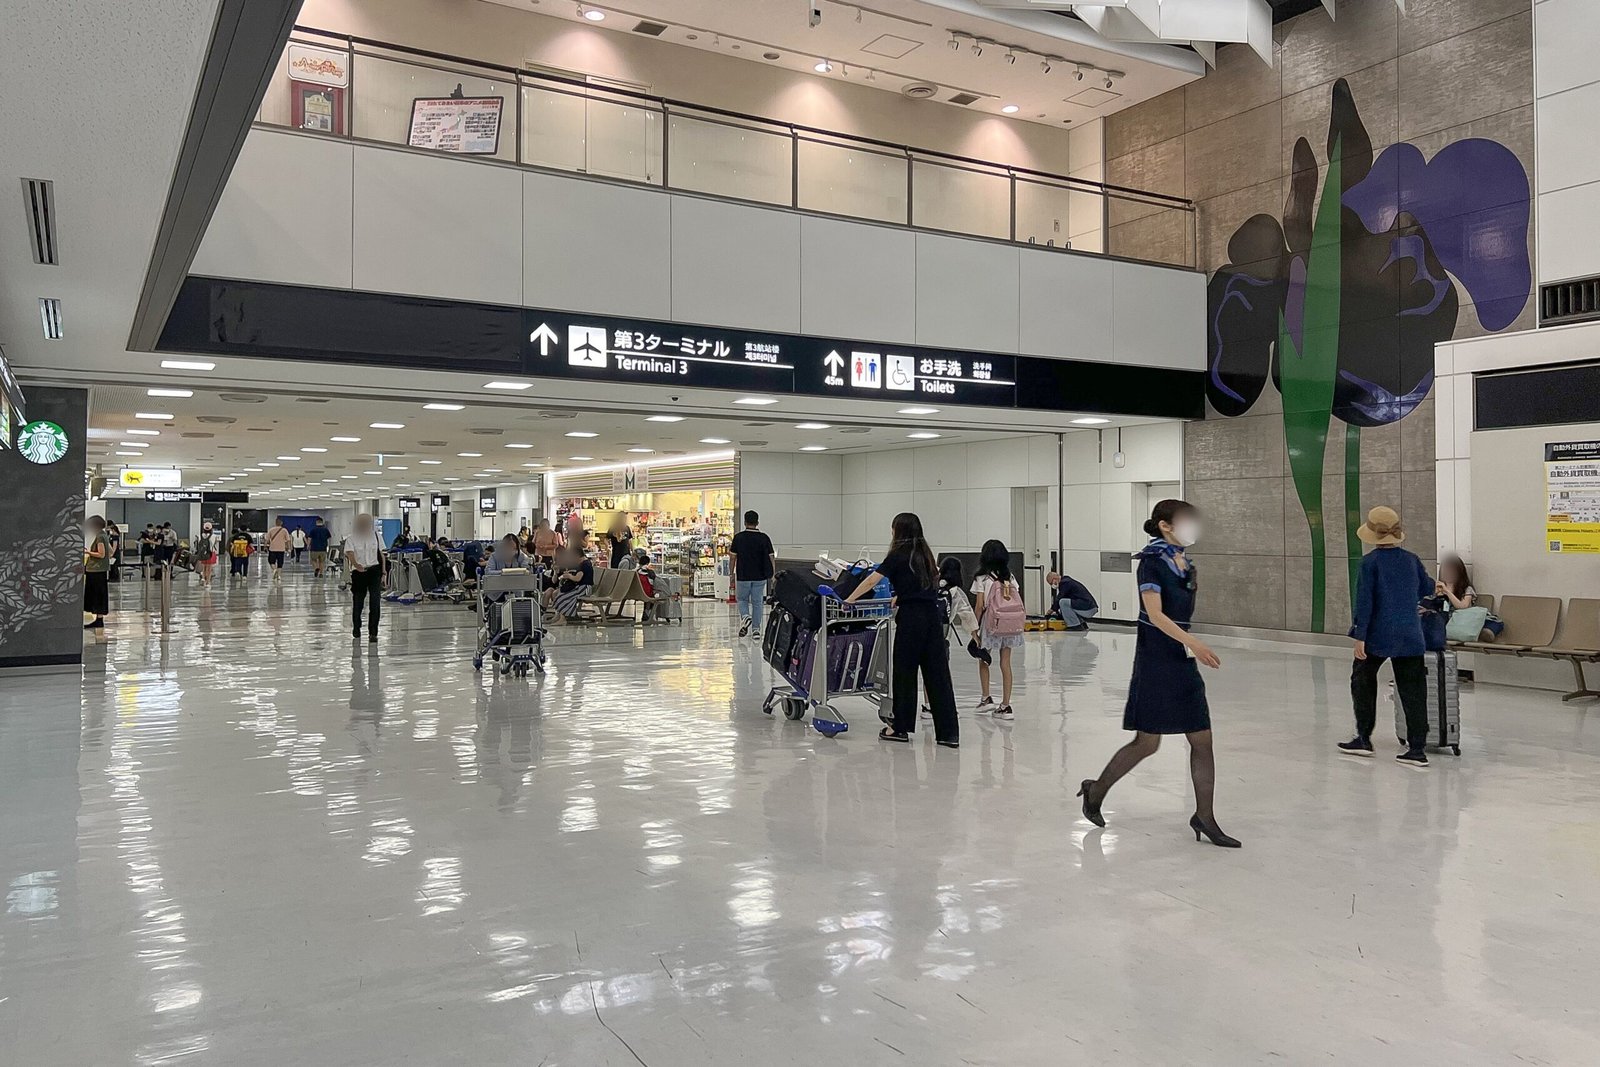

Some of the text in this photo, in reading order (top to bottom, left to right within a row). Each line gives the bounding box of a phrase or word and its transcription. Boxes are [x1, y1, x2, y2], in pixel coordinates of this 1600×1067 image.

[614, 329, 730, 357] 第3ターミナル
[615, 355, 688, 375] Terminal 3
[919, 358, 962, 377] お手洗
[824, 376, 844, 386] 45m
[920, 379, 955, 394] Toilets
